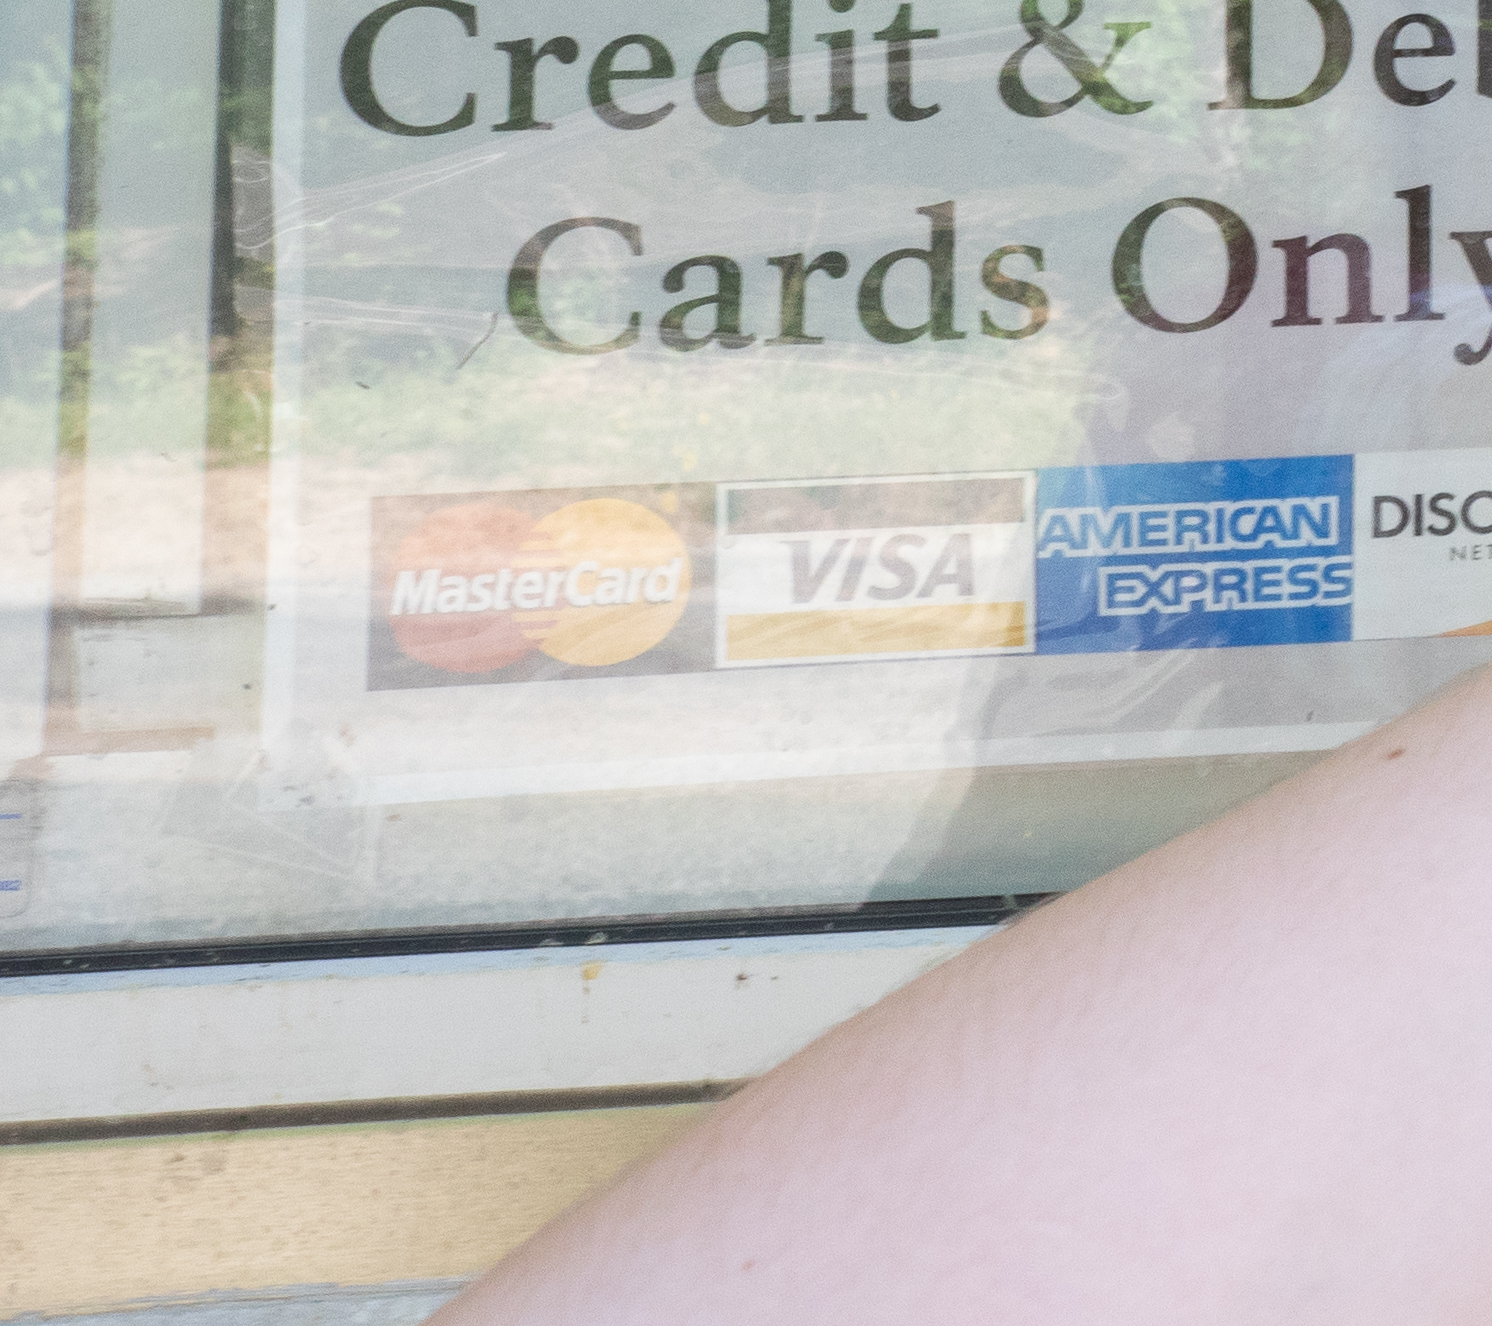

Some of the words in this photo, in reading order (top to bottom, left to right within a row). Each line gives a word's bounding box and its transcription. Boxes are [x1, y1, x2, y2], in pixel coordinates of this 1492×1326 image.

[505, 201, 1050, 360] Cards
[1038, 496, 1340, 557] AMERICAN
[390, 556, 683, 616] MasterCard
[779, 532, 976, 604] VISA
[1099, 558, 1353, 616] EXPRESS
